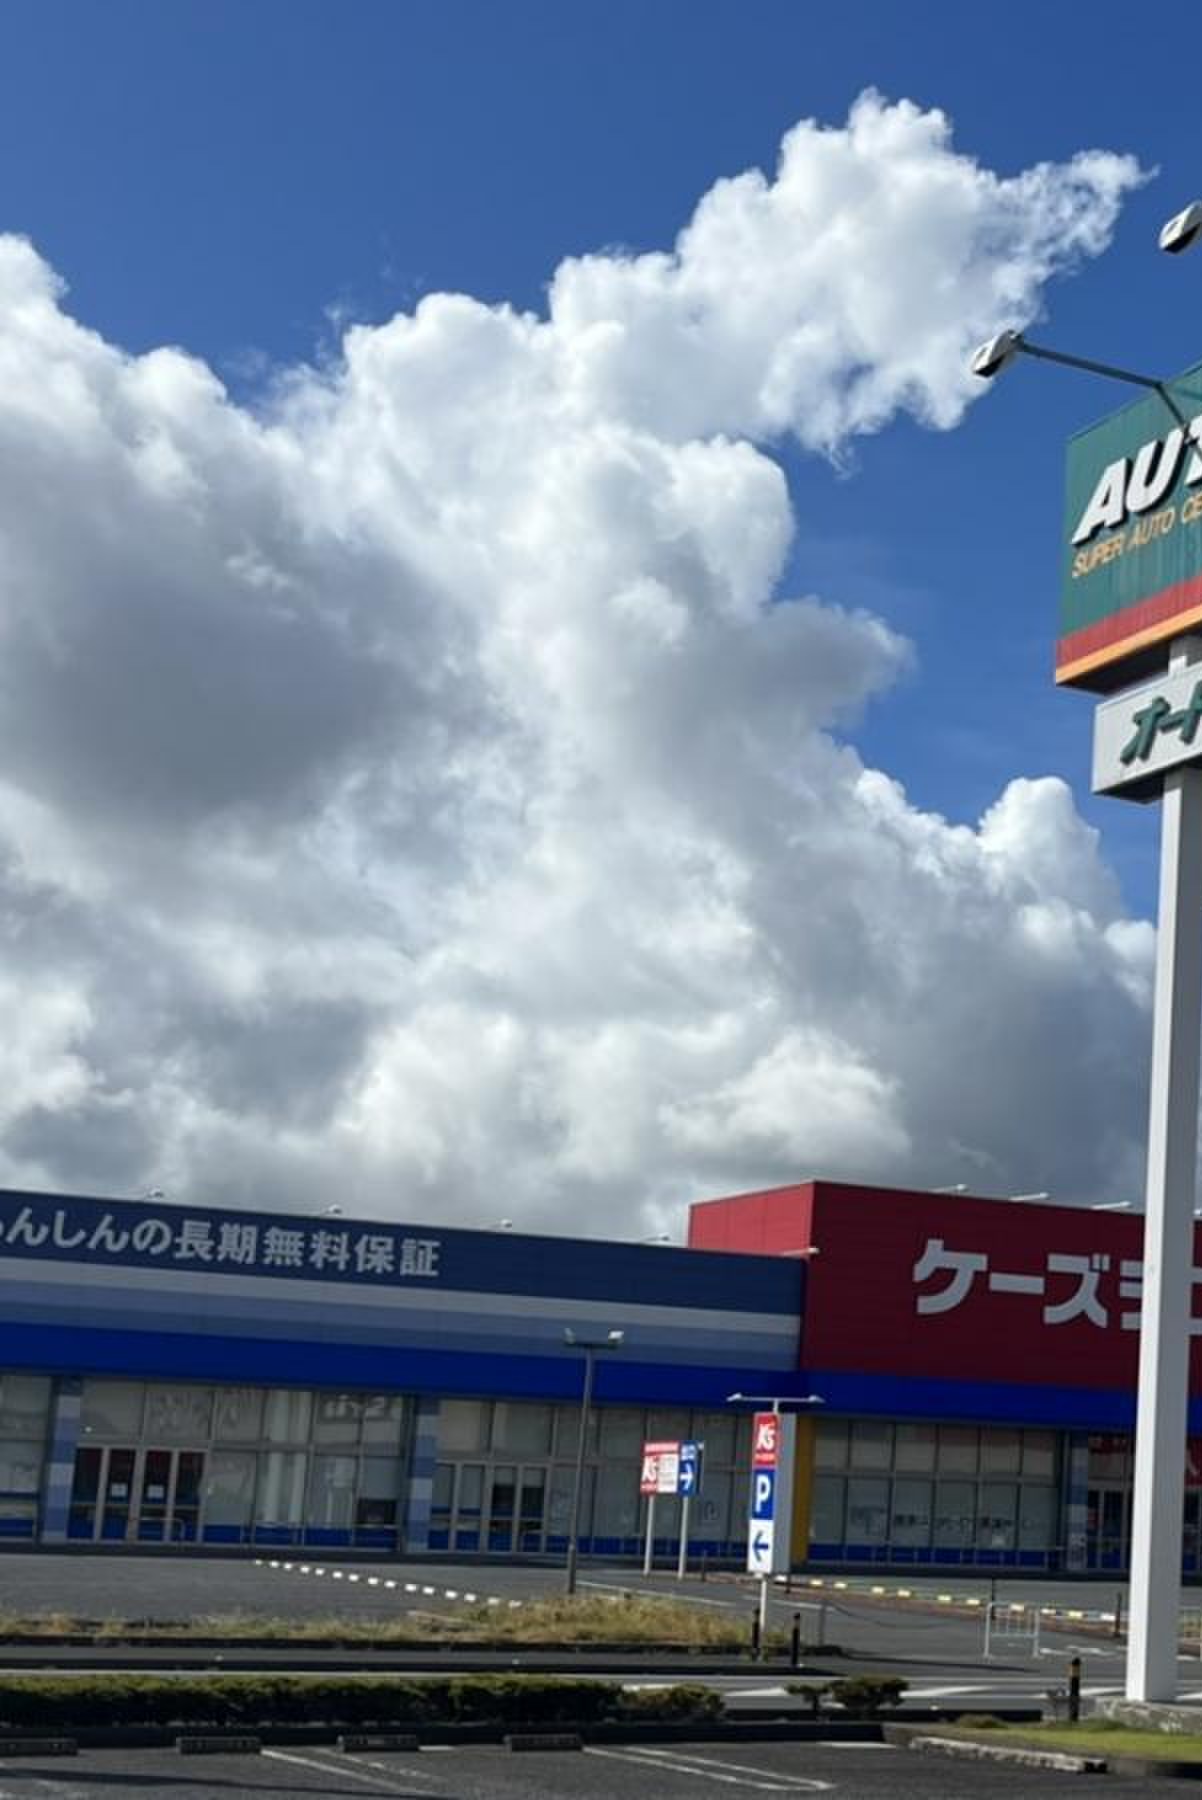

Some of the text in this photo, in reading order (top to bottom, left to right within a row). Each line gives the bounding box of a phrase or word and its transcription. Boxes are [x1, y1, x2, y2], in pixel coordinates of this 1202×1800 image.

[1072, 533, 1126, 579] SUPER
[1129, 508, 1176, 549] AUTO
[0, 1207, 442, 1278] んしんの長期無料保証
[755, 1474, 770, 1513] P
